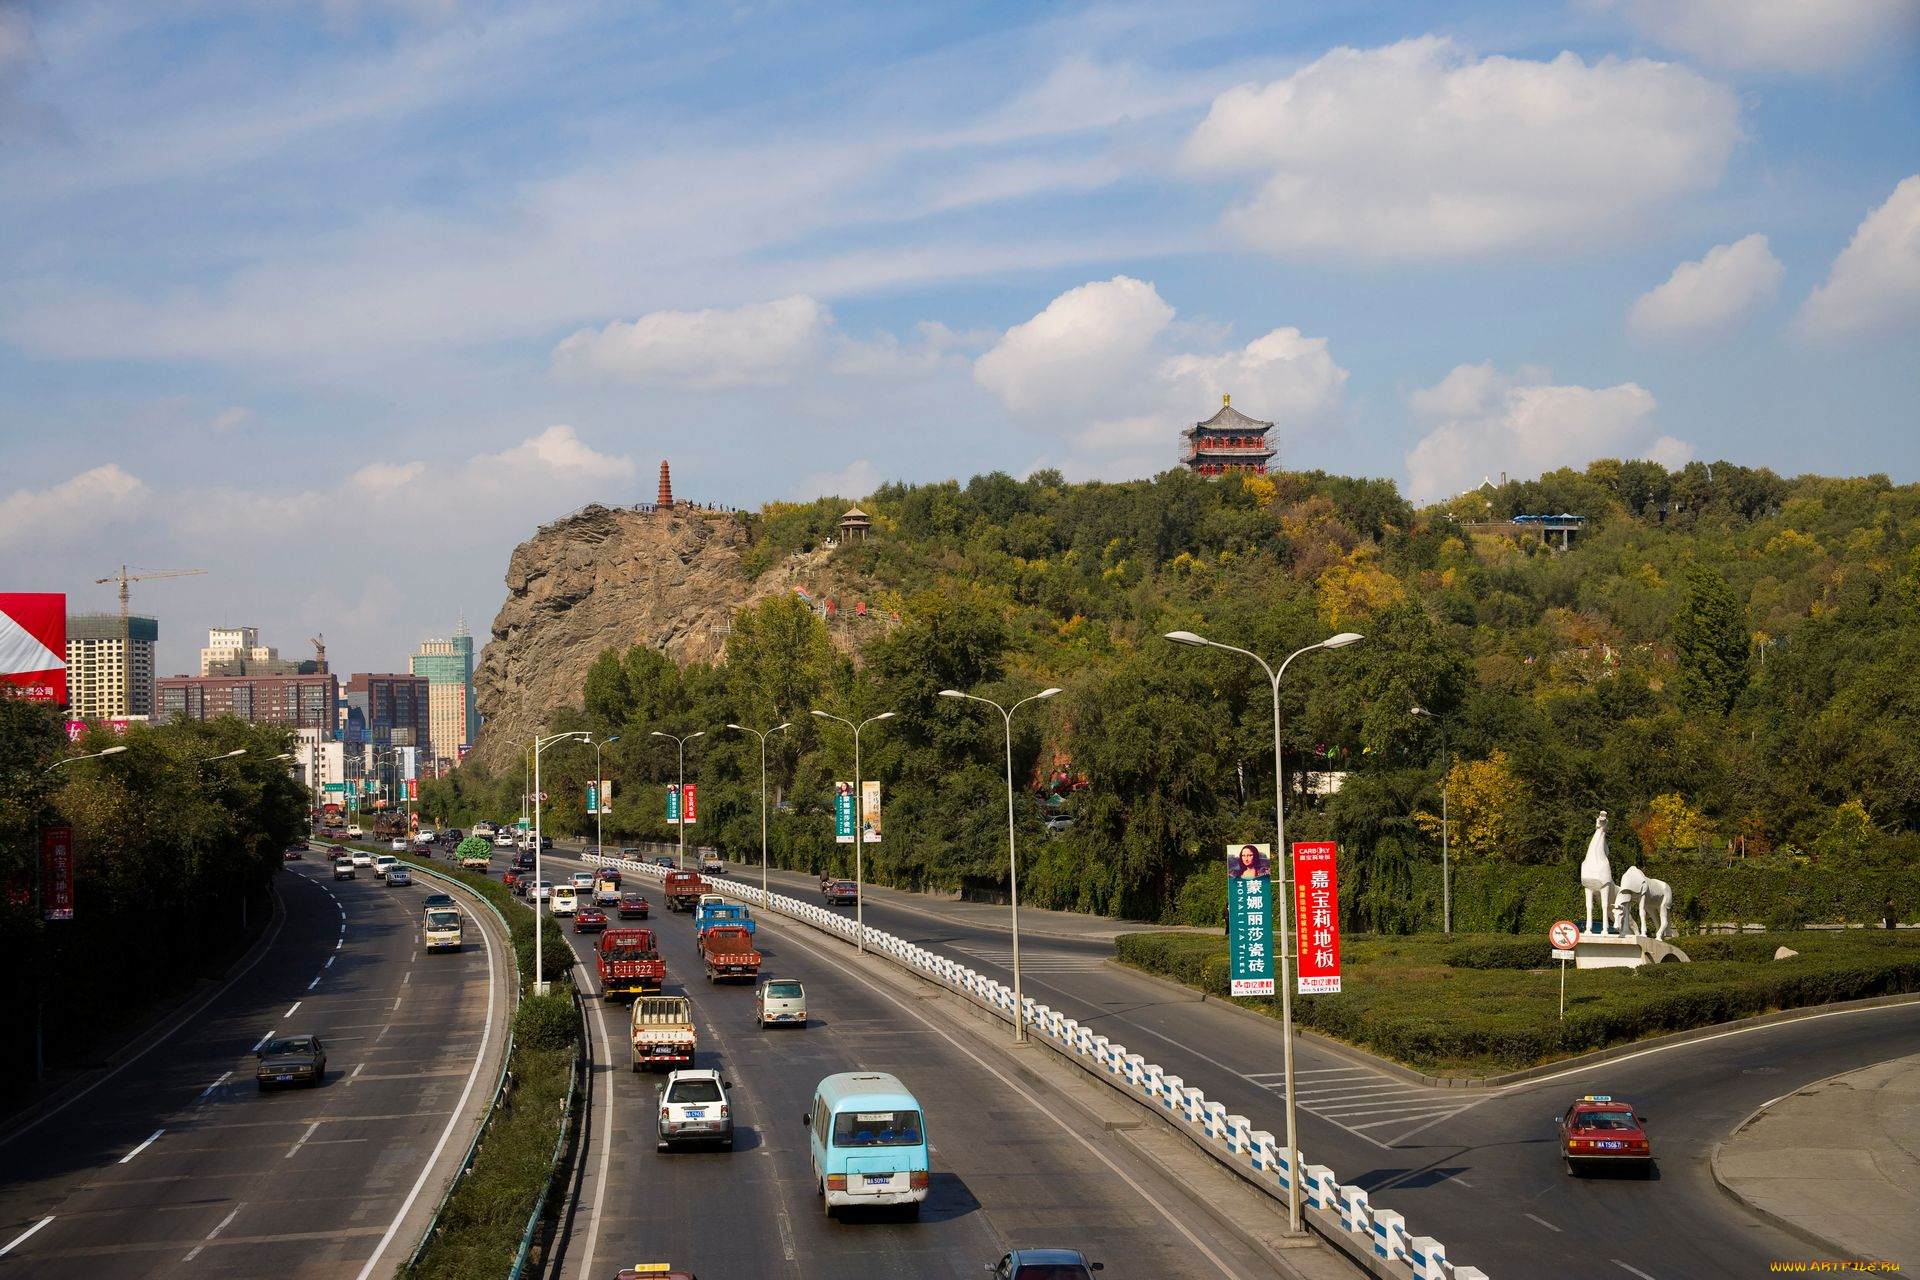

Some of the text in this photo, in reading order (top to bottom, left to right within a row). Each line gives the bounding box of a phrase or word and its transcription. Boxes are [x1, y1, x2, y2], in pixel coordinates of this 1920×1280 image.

[1246, 880, 1265, 973] 蒙娜丽莎瓷砖
[1311, 870, 1334, 968] 嘉宝莉地板
